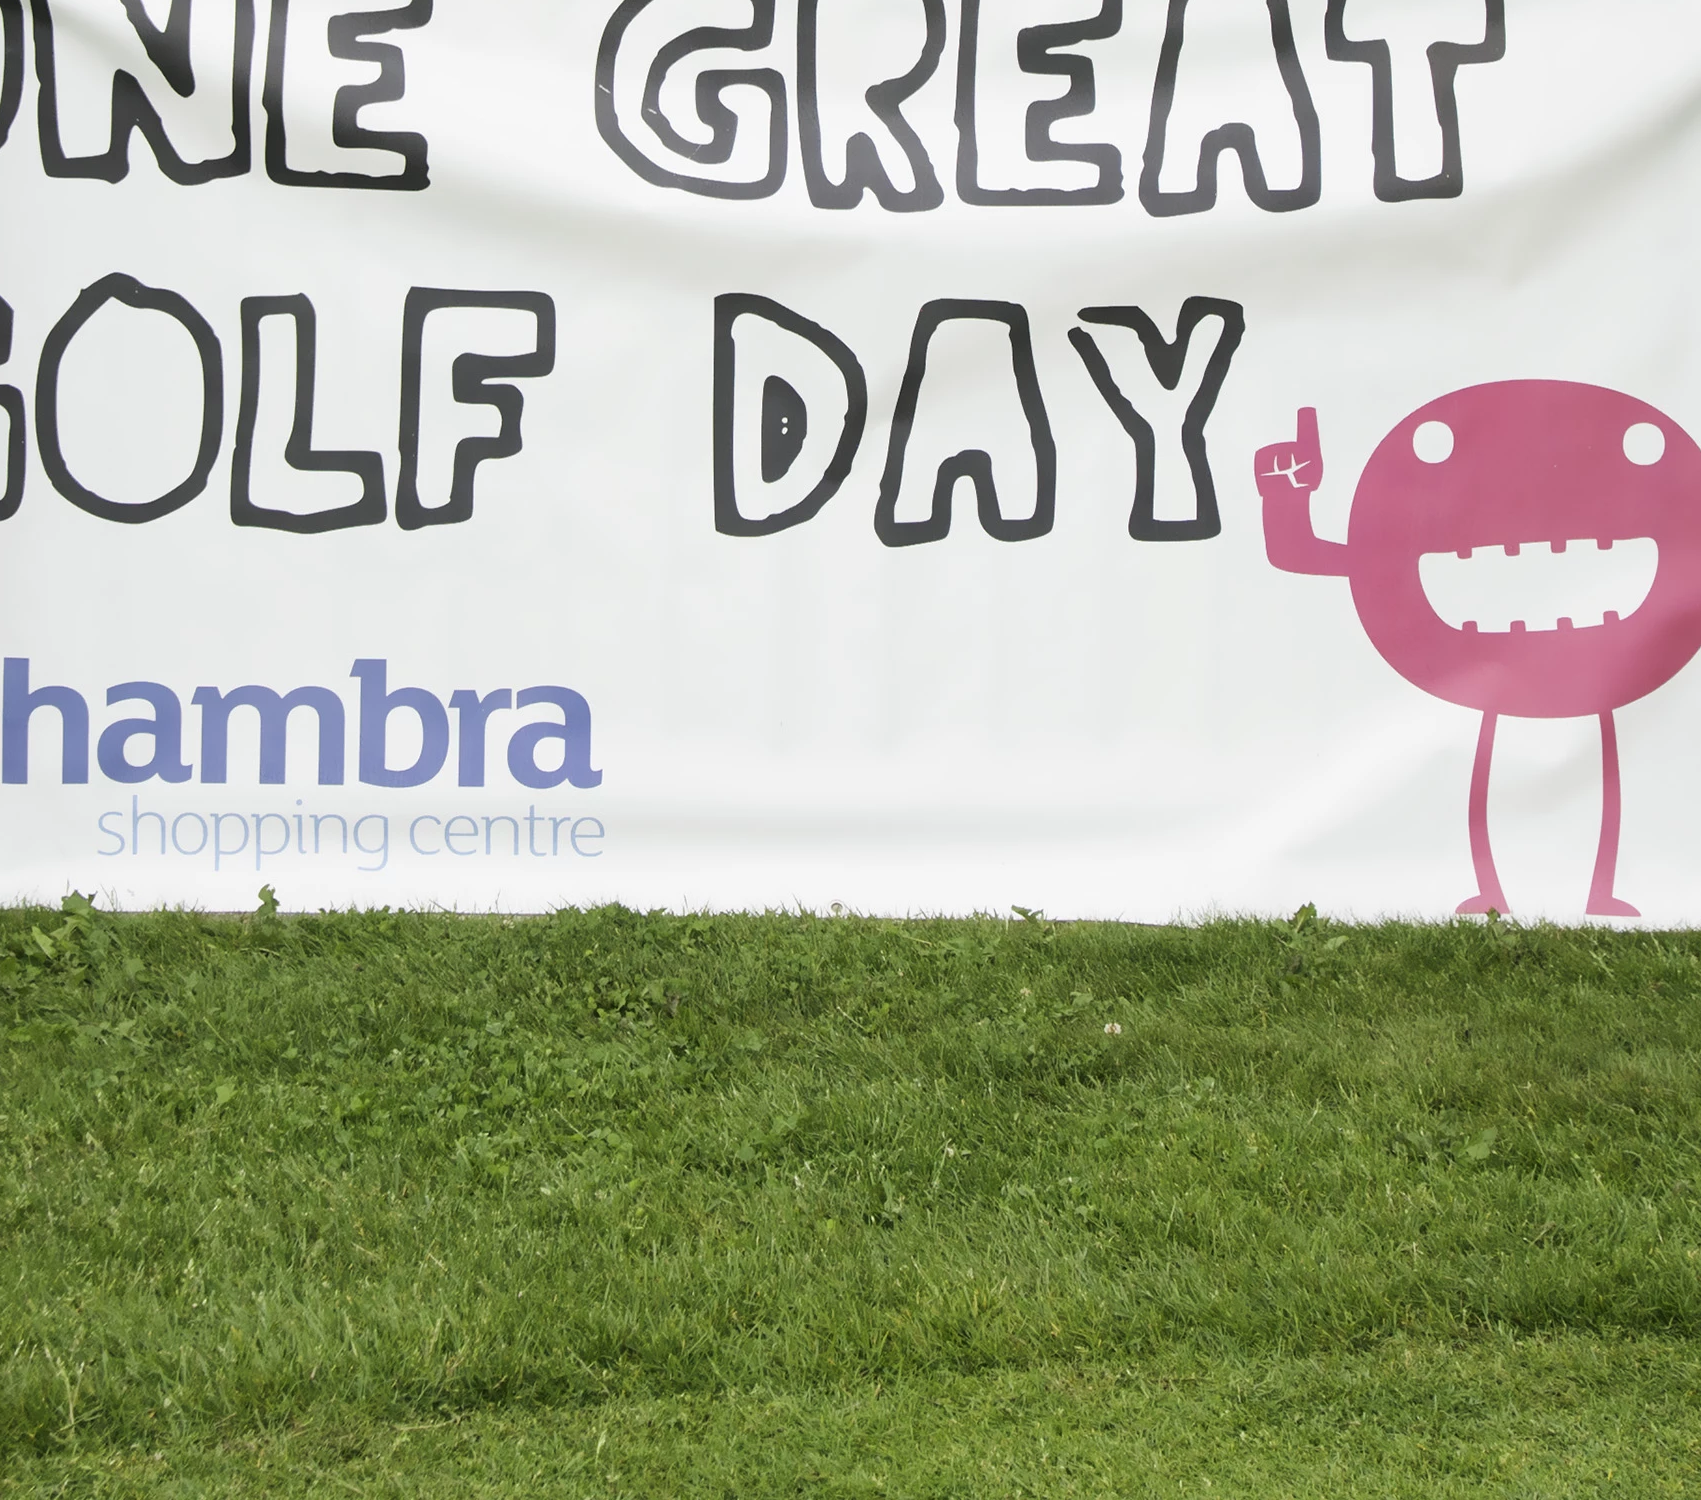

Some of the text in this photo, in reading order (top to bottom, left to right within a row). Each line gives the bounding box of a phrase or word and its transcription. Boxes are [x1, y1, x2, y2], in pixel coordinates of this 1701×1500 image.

[713, 293, 1245, 548] DAY
[97, 794, 606, 872] shopping centre
